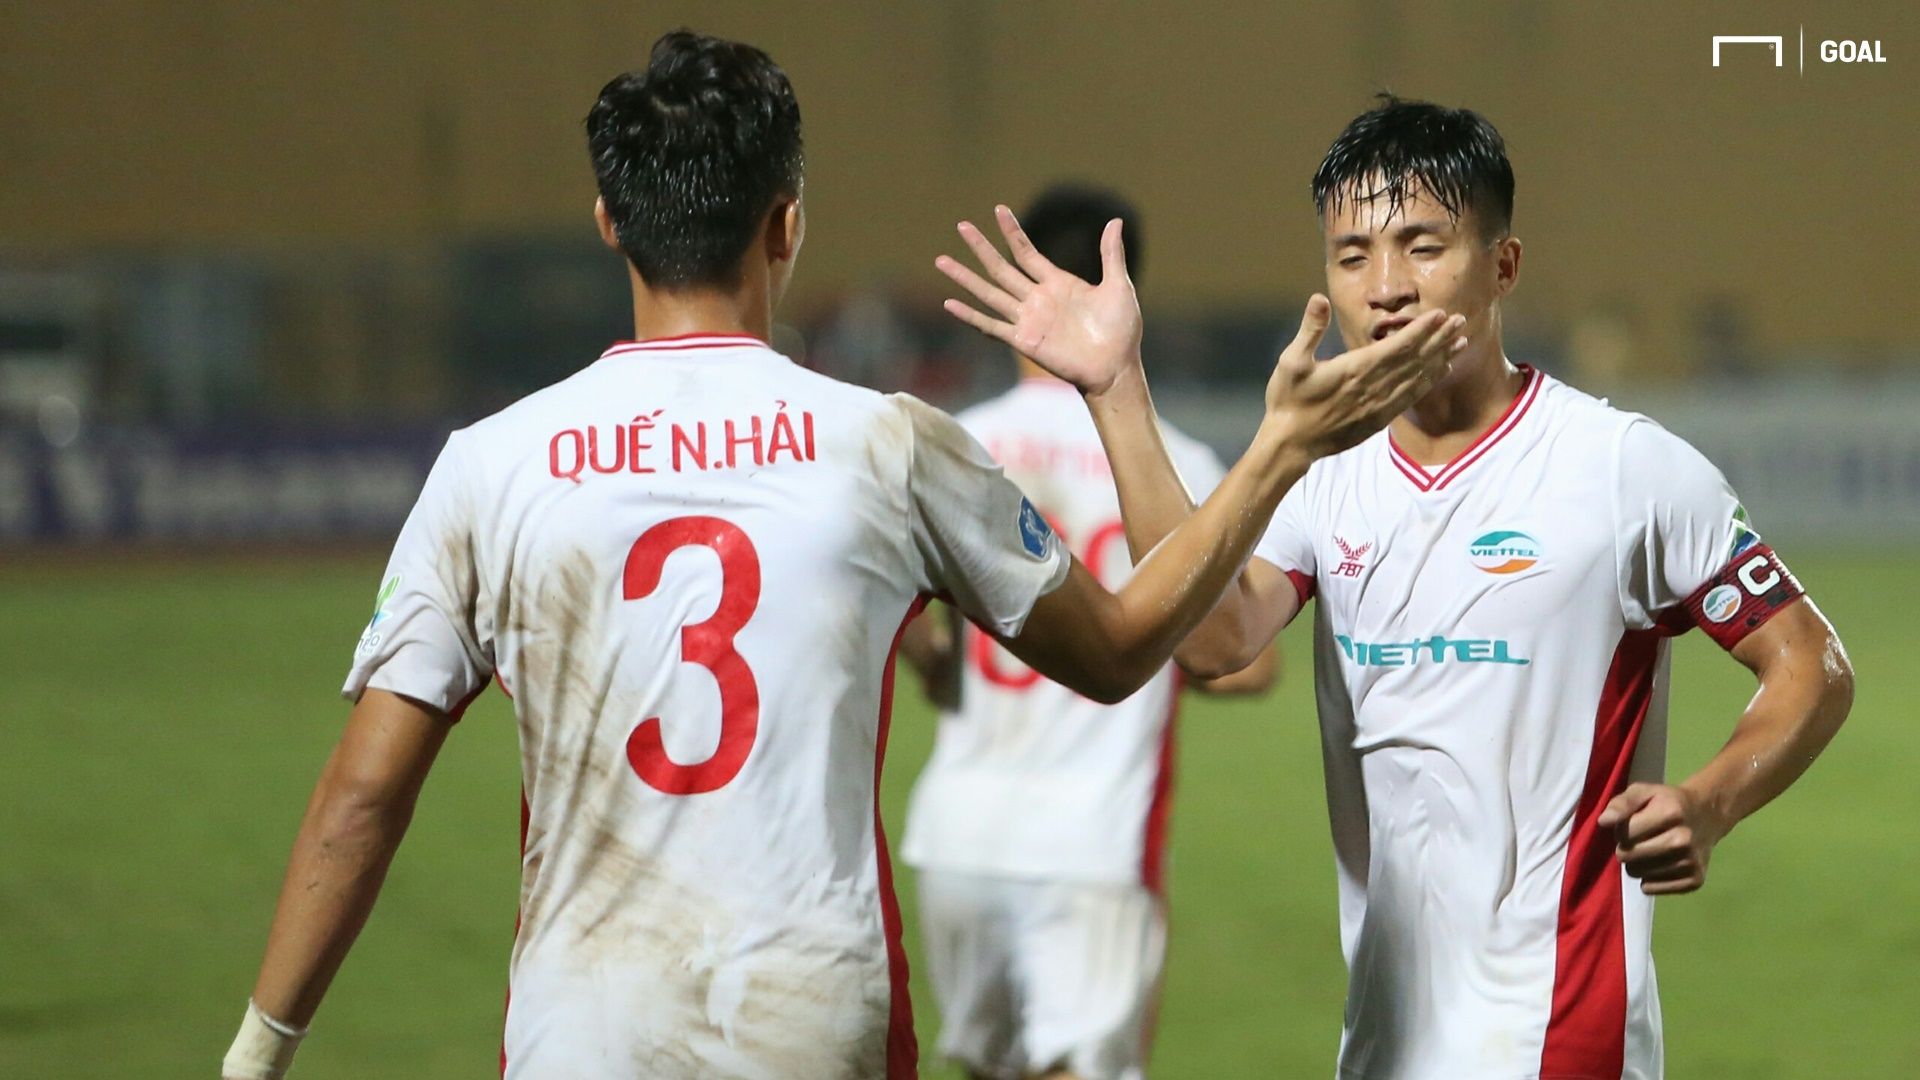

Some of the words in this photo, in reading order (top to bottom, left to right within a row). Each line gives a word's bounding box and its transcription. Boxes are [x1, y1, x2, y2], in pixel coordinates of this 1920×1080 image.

[549, 409, 665, 484] QUẾ
[671, 399, 816, 473] N.HẢI
[1737, 554, 1781, 597] C
[622, 515, 762, 796] 3
